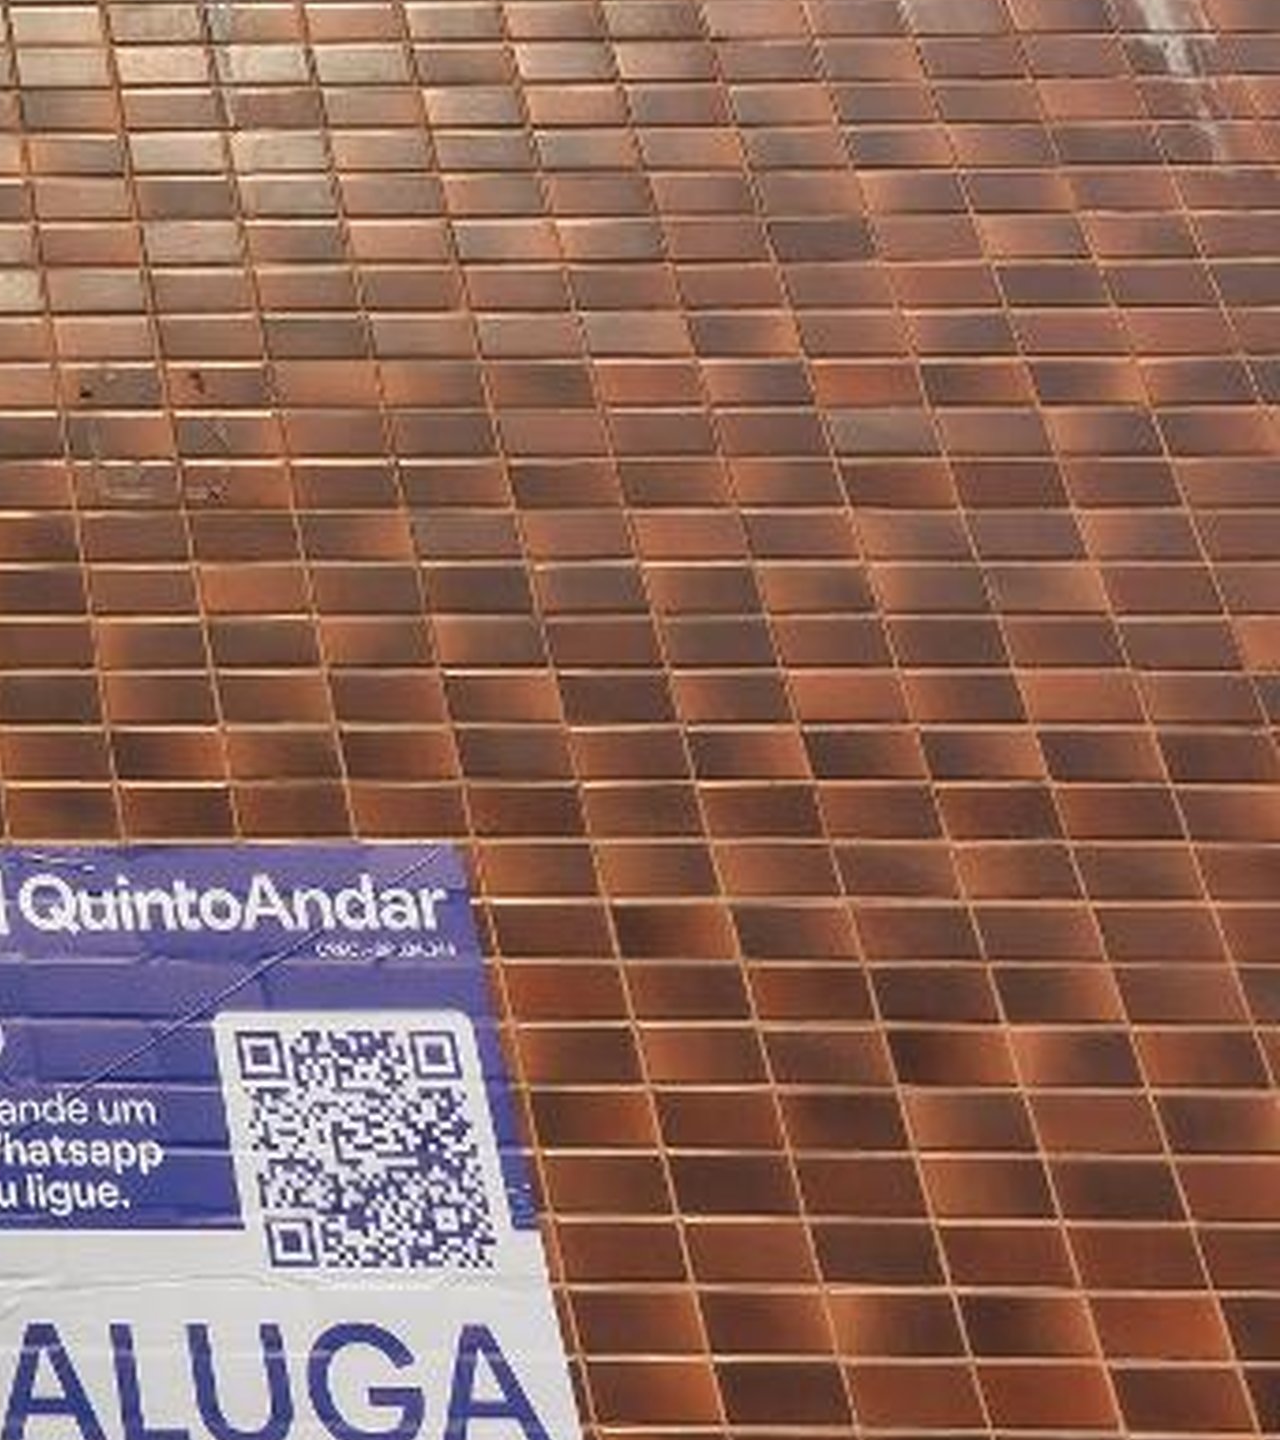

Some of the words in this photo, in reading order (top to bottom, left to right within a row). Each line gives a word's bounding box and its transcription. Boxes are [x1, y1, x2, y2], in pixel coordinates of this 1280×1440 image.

[18, 872, 447, 935] QuintoAndar
[97, 1097, 158, 1126] um
[26, 1173, 131, 1217] ligue.
